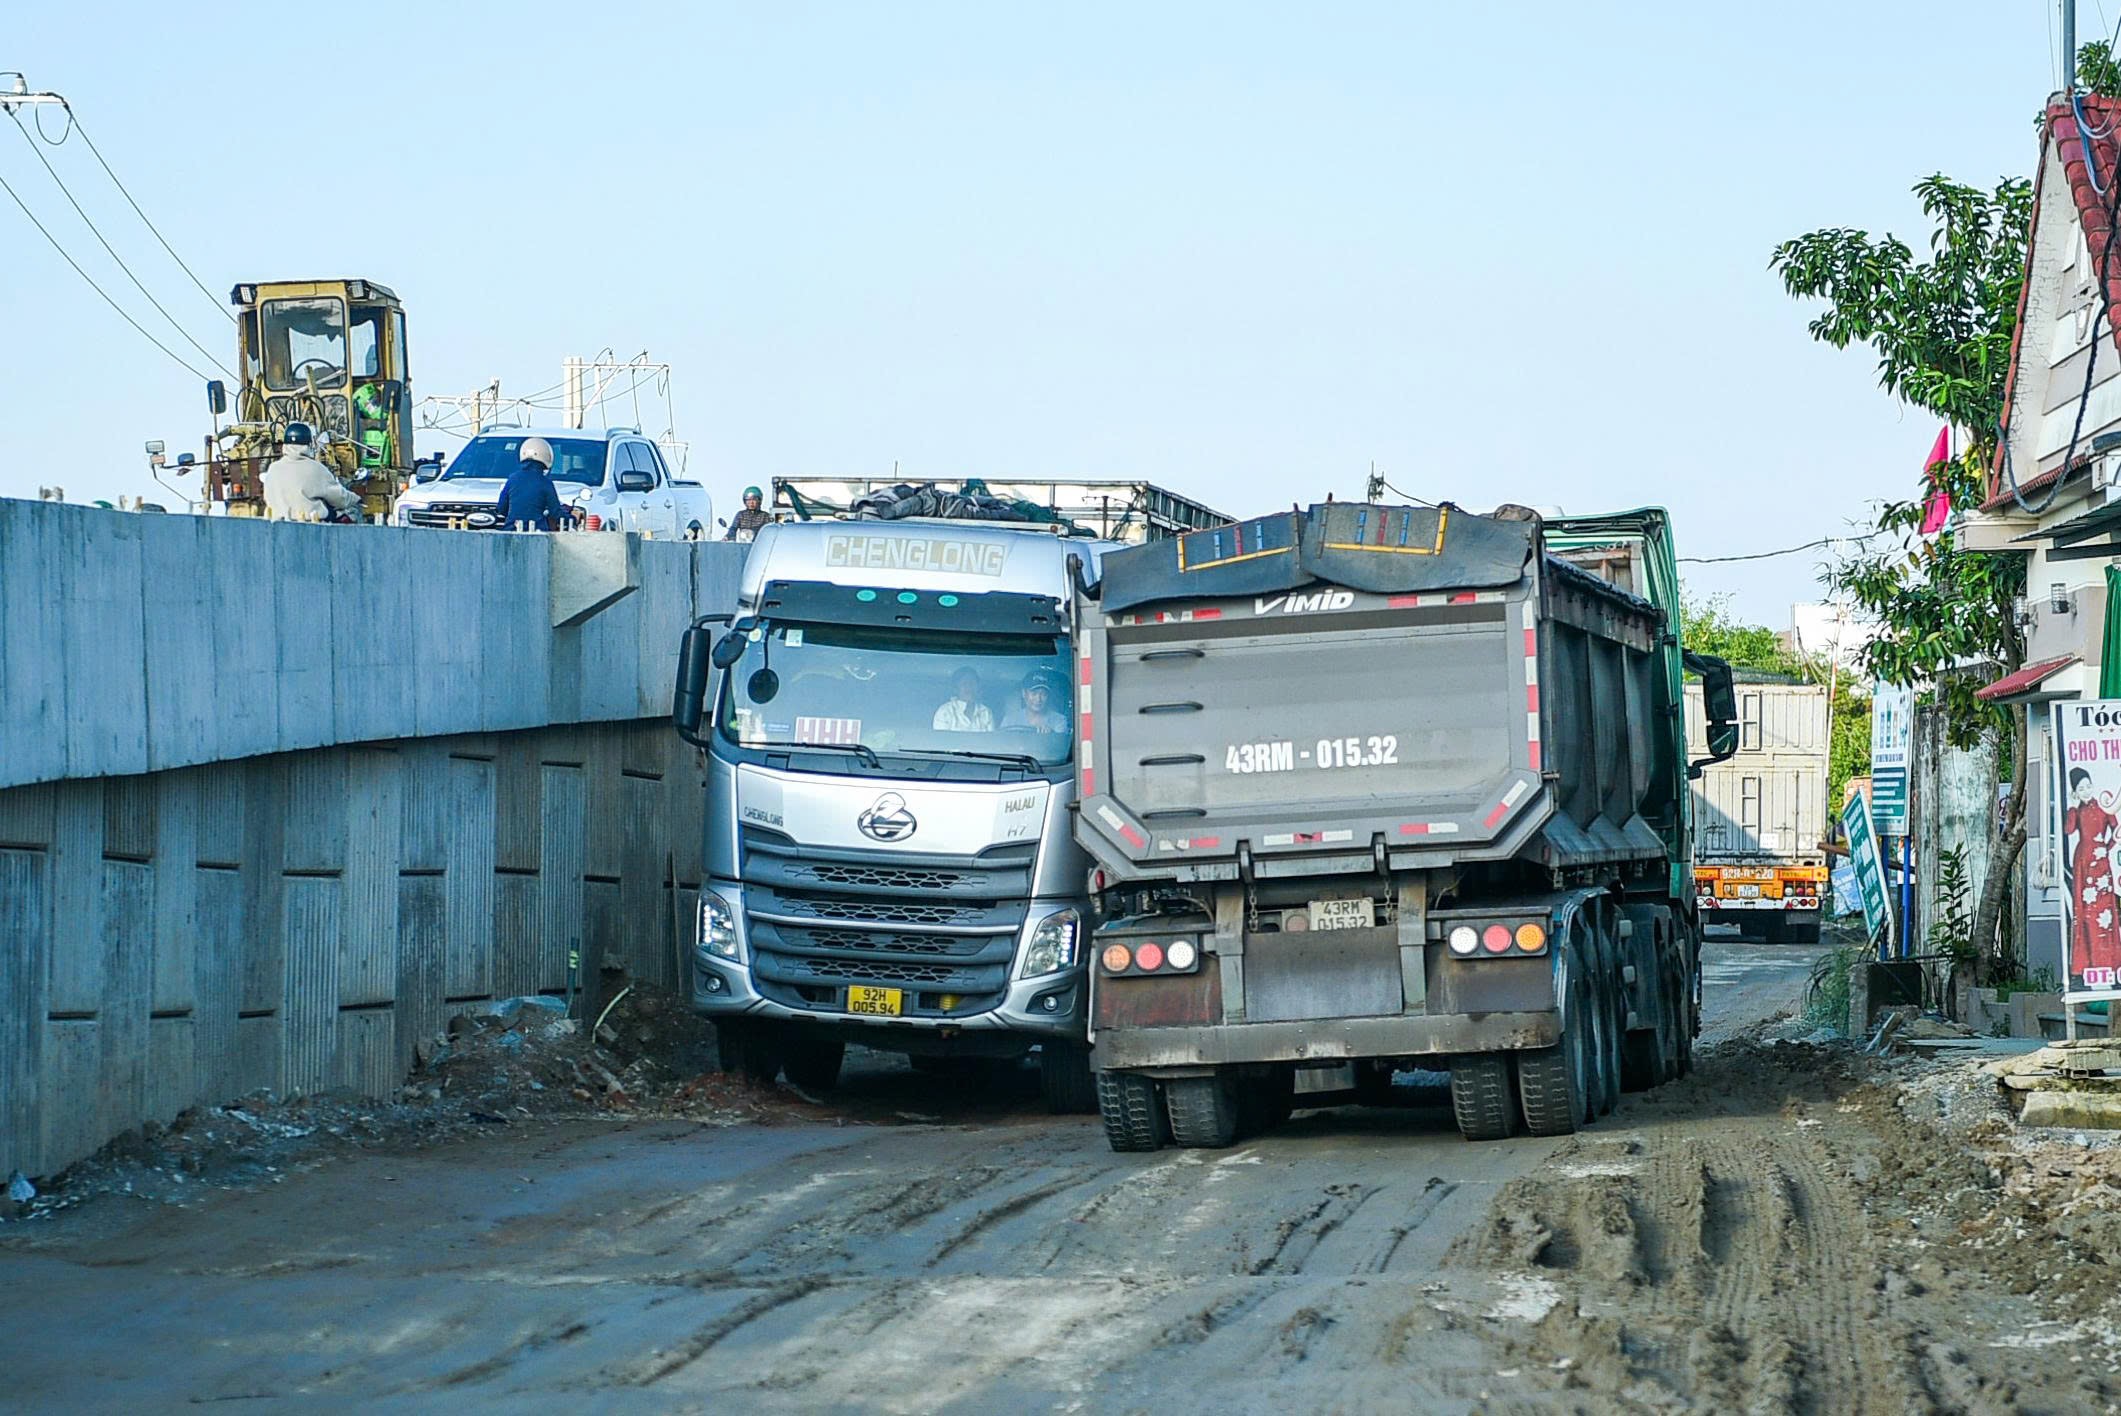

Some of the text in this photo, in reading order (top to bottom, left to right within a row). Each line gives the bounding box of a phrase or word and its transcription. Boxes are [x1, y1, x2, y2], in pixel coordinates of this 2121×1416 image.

[827, 536, 1005, 577] CHENGLONG
[1225, 742, 1294, 774] 43RM
[1316, 735, 1398, 769] 015.32
[2069, 740, 2121, 761] CHO TH
[1322, 901, 1361, 916] 43RM
[863, 988, 887, 1001] 92H
[852, 1001, 895, 1015] 005.94
